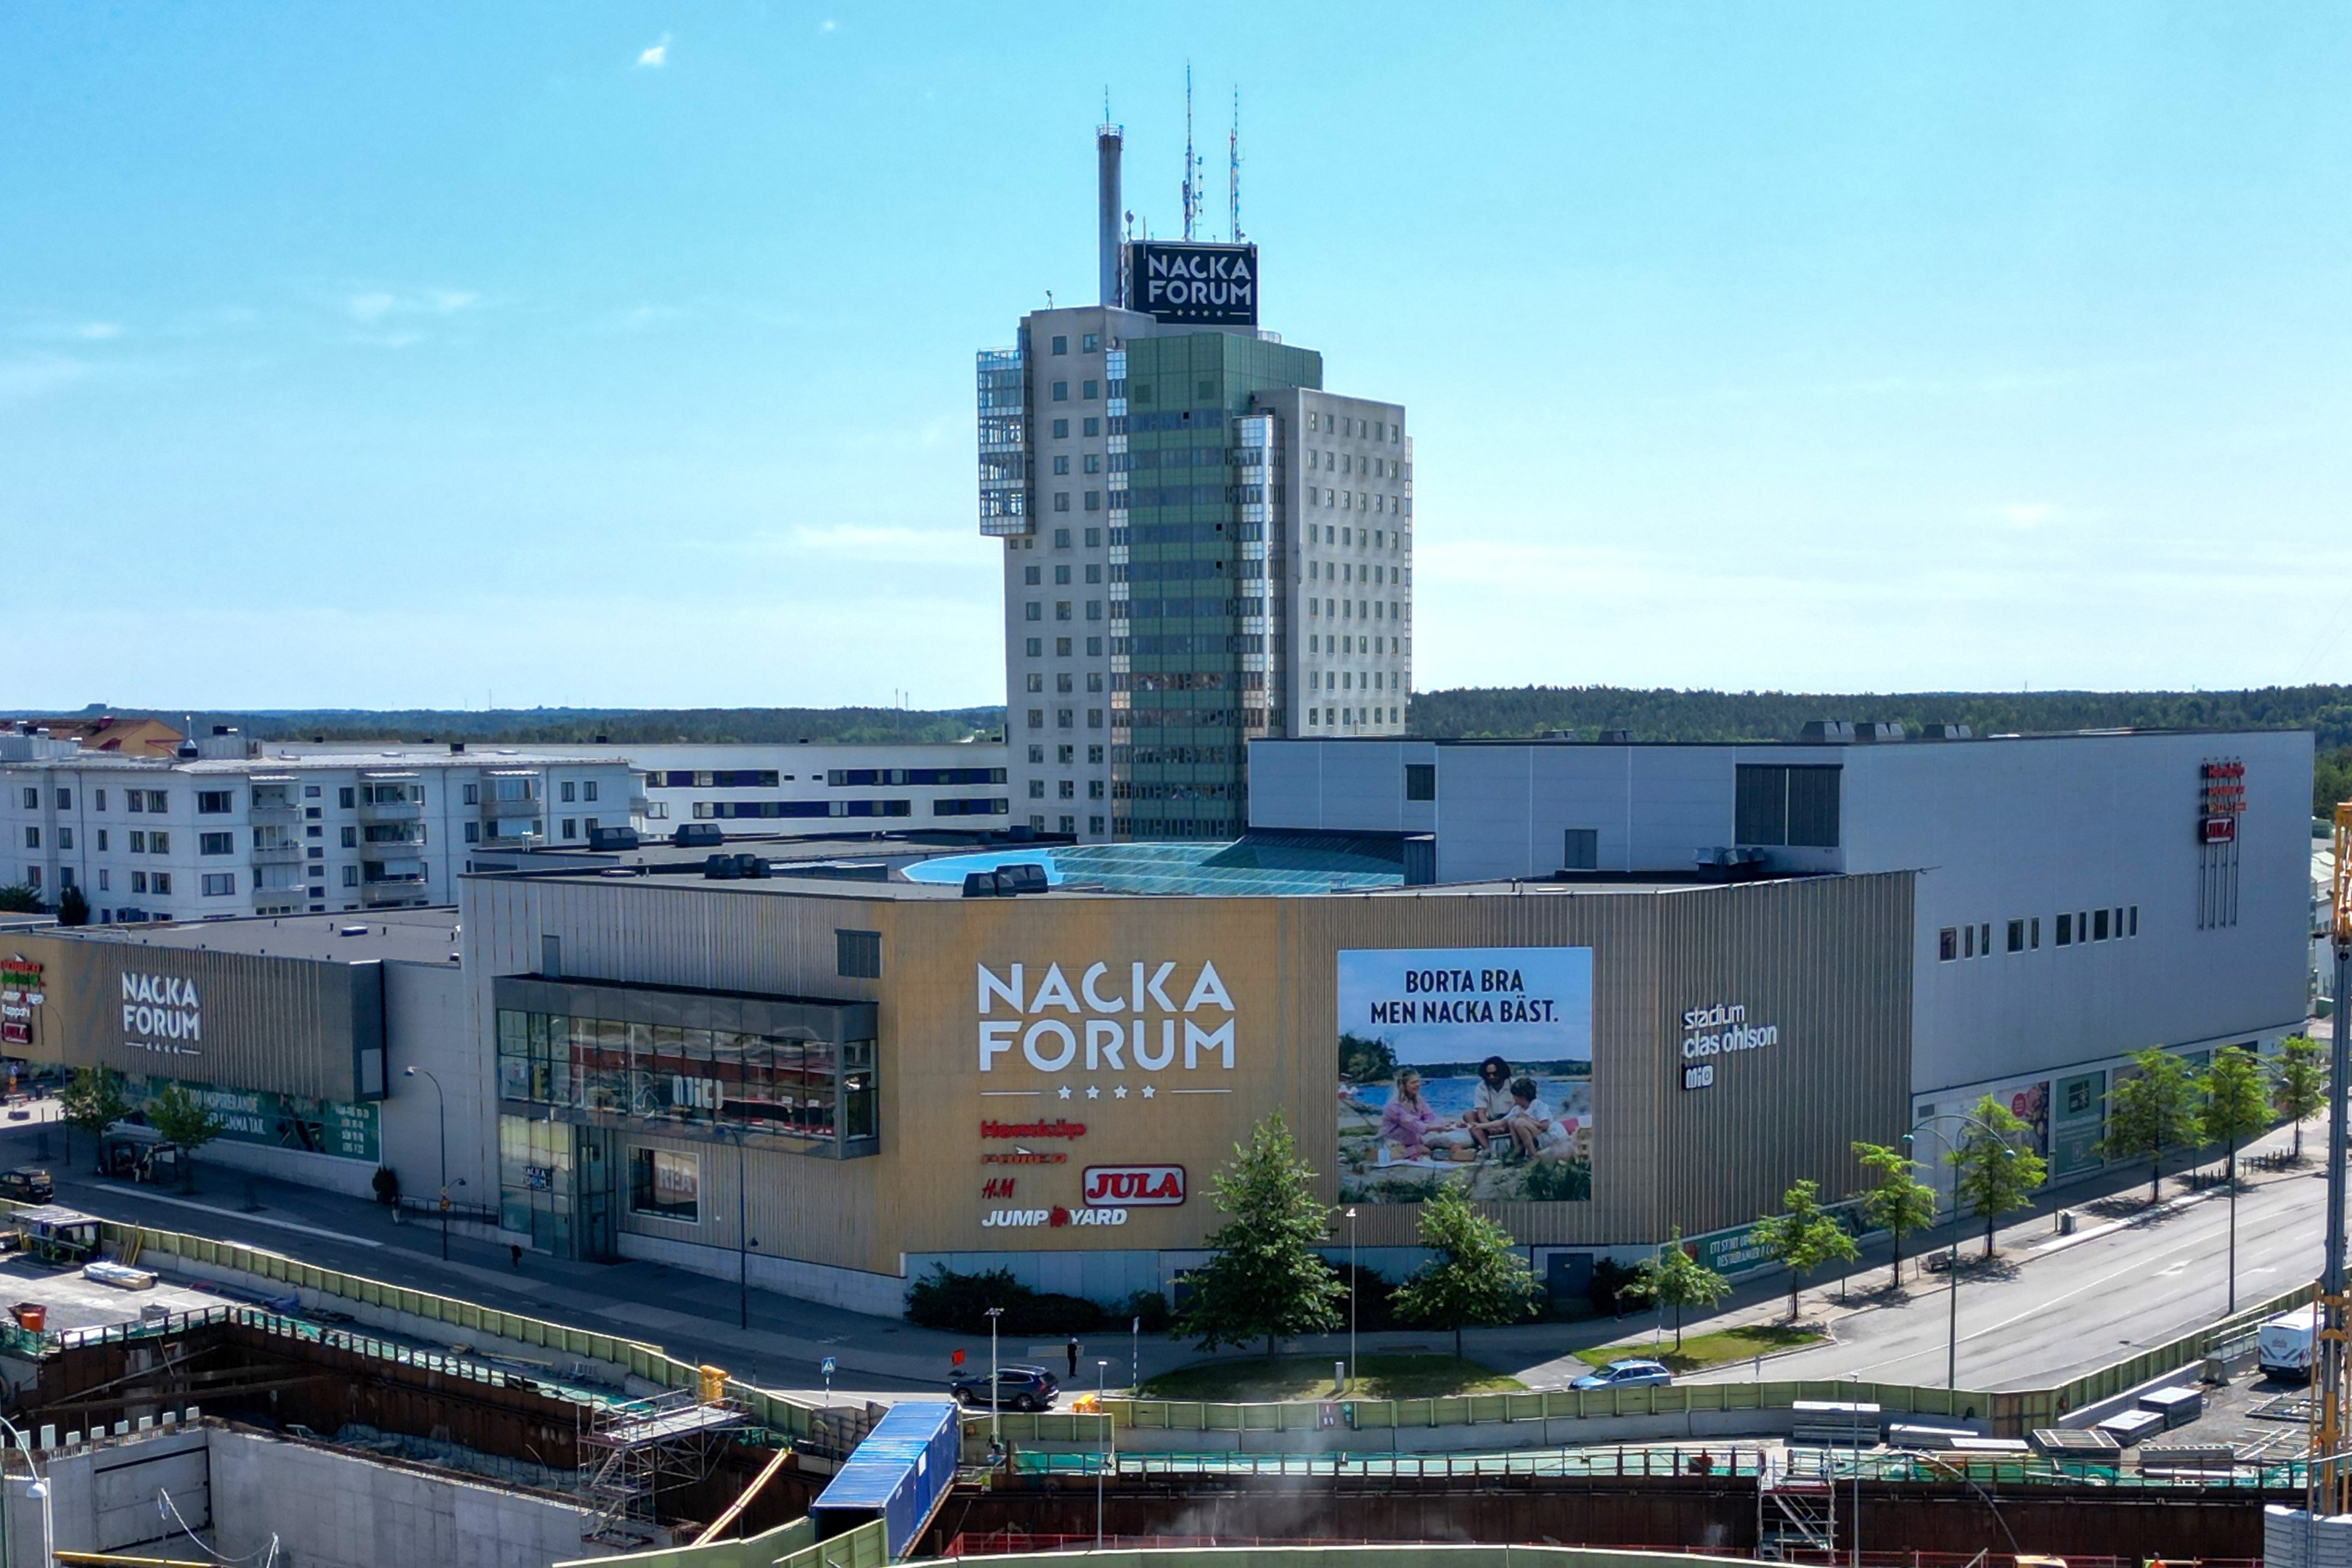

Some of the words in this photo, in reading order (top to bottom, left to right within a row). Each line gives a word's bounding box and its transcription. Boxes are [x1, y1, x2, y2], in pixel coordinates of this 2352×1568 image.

[1148, 254, 1251, 279] NACKA
[1148, 280, 1251, 305] FORUM
[122, 971, 200, 1008] NACKA
[978, 960, 1235, 1015] NACKA
[1405, 970, 1475, 993] BORTA
[1481, 969, 1524, 992] BRA
[123, 1004, 200, 1041] FORUM
[1371, 1001, 1416, 1024] MEN
[1422, 1000, 1494, 1024] NACKA
[1500, 995, 1559, 1023] BÄST.
[1684, 1003, 1745, 1030] stadium
[979, 1017, 1234, 1072] FORUM
[1683, 1031, 1720, 1058] clas
[1722, 1023, 1777, 1052] ohlson
[1087, 1172, 1183, 1199] JULA
[981, 1209, 1049, 1227] JUMP
[1069, 1209, 1128, 1225] YARD
